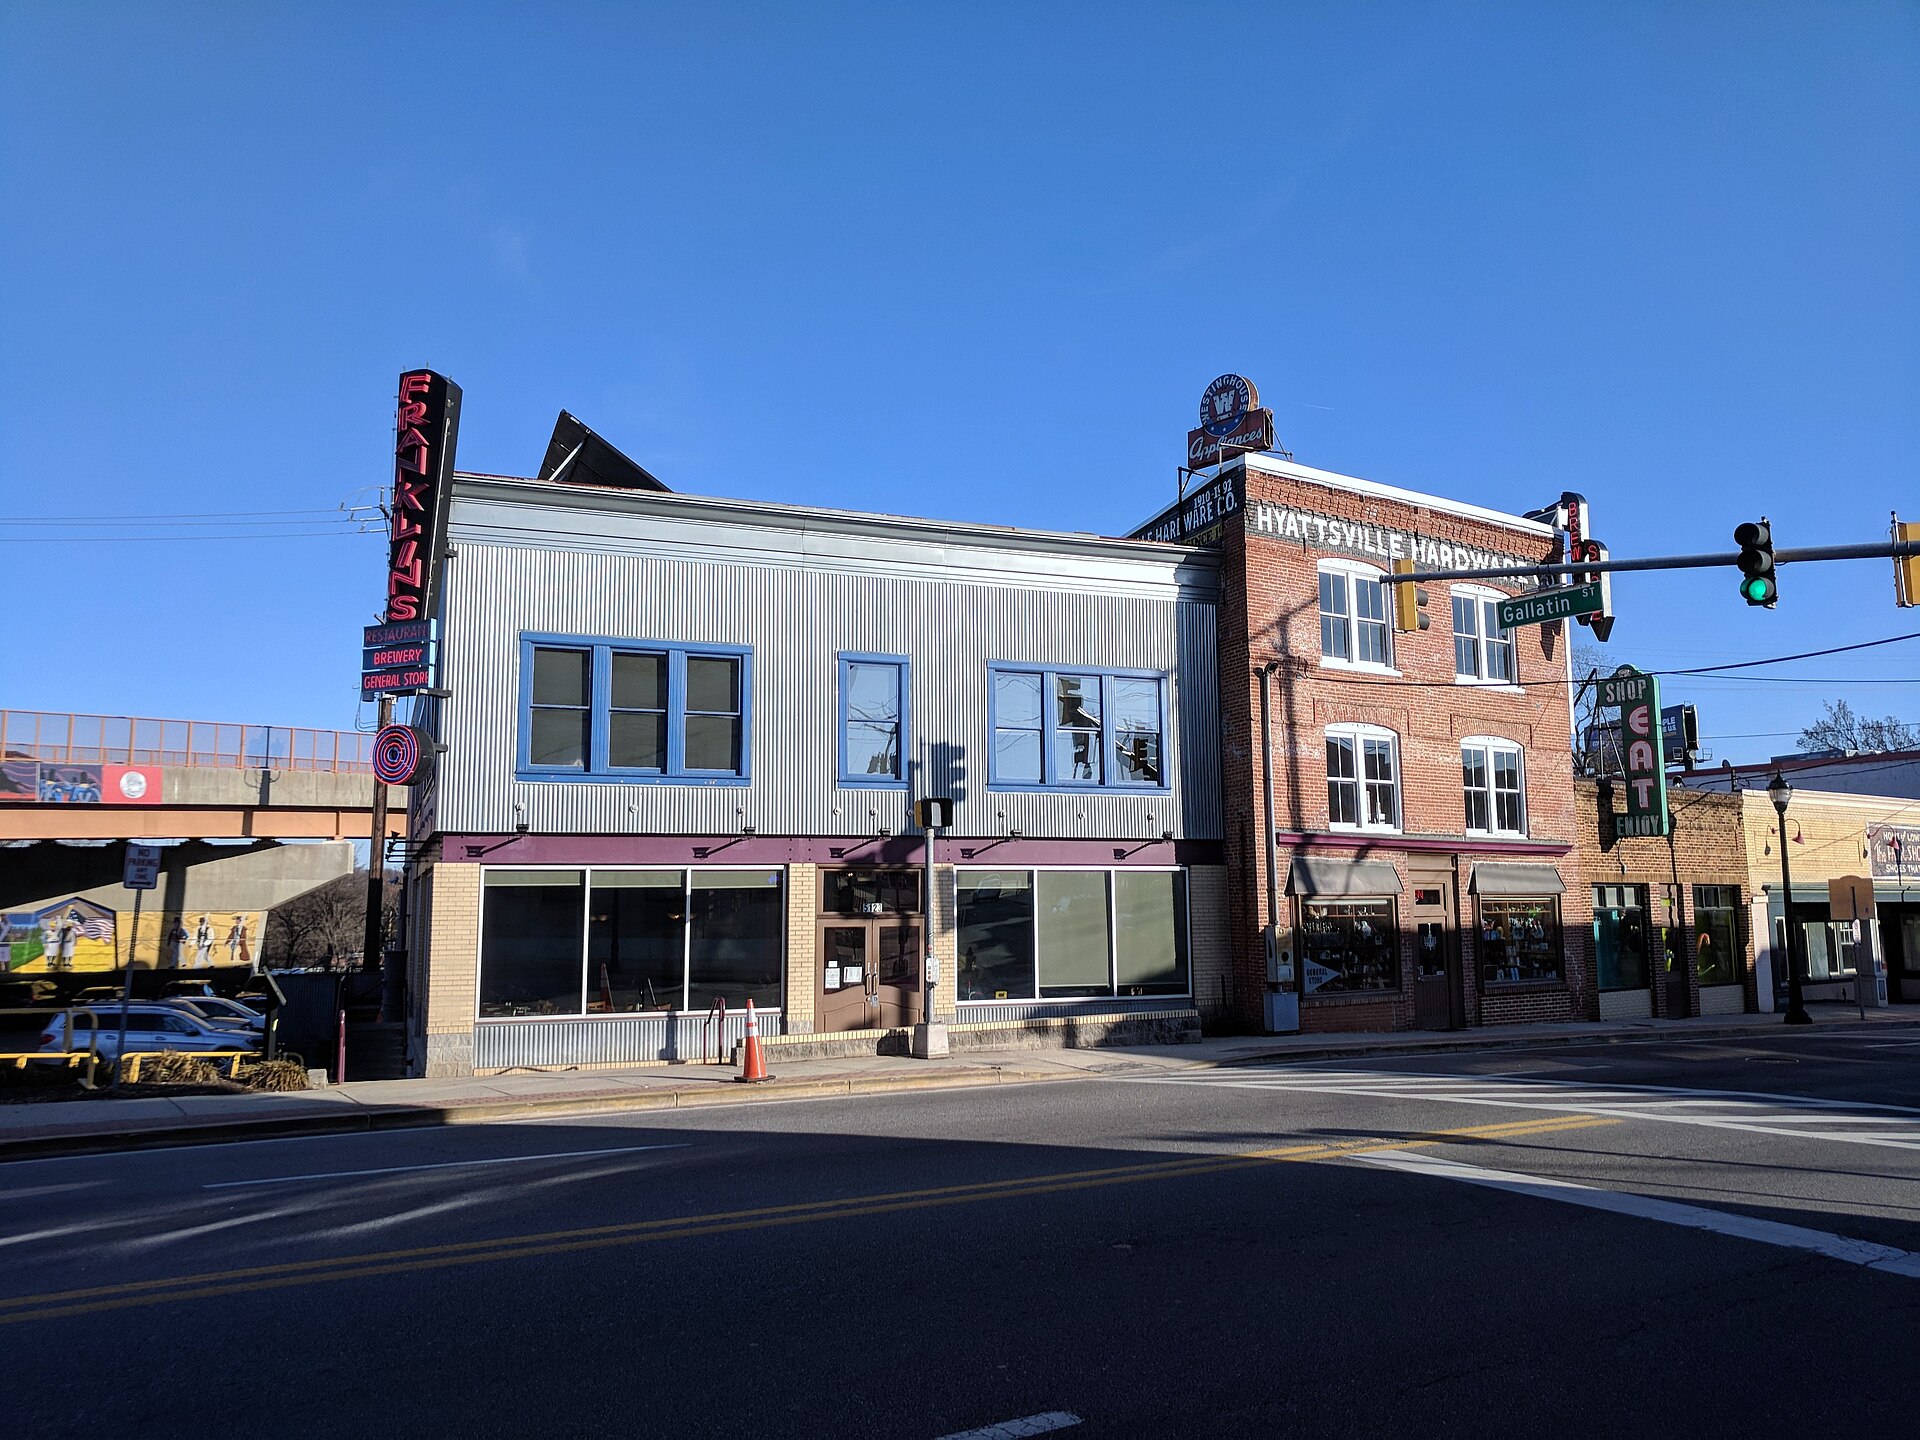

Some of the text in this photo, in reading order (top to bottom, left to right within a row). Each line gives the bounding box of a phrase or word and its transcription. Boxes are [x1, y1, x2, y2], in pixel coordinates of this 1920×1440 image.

[1201, 375, 1249, 425] WESTINGHOUSE
[1189, 427, 1263, 461] Appliances
[1257, 505, 1405, 559] HYATTSVILLE
[1503, 586, 1595, 623] Gallatin ST
[373, 648, 423, 666] BREWERY
[364, 674, 401, 689] GENERAL
[1605, 679, 1646, 703] SHOP
[1629, 705, 1654, 809] EAT
[1616, 814, 1660, 836] ENJOY
